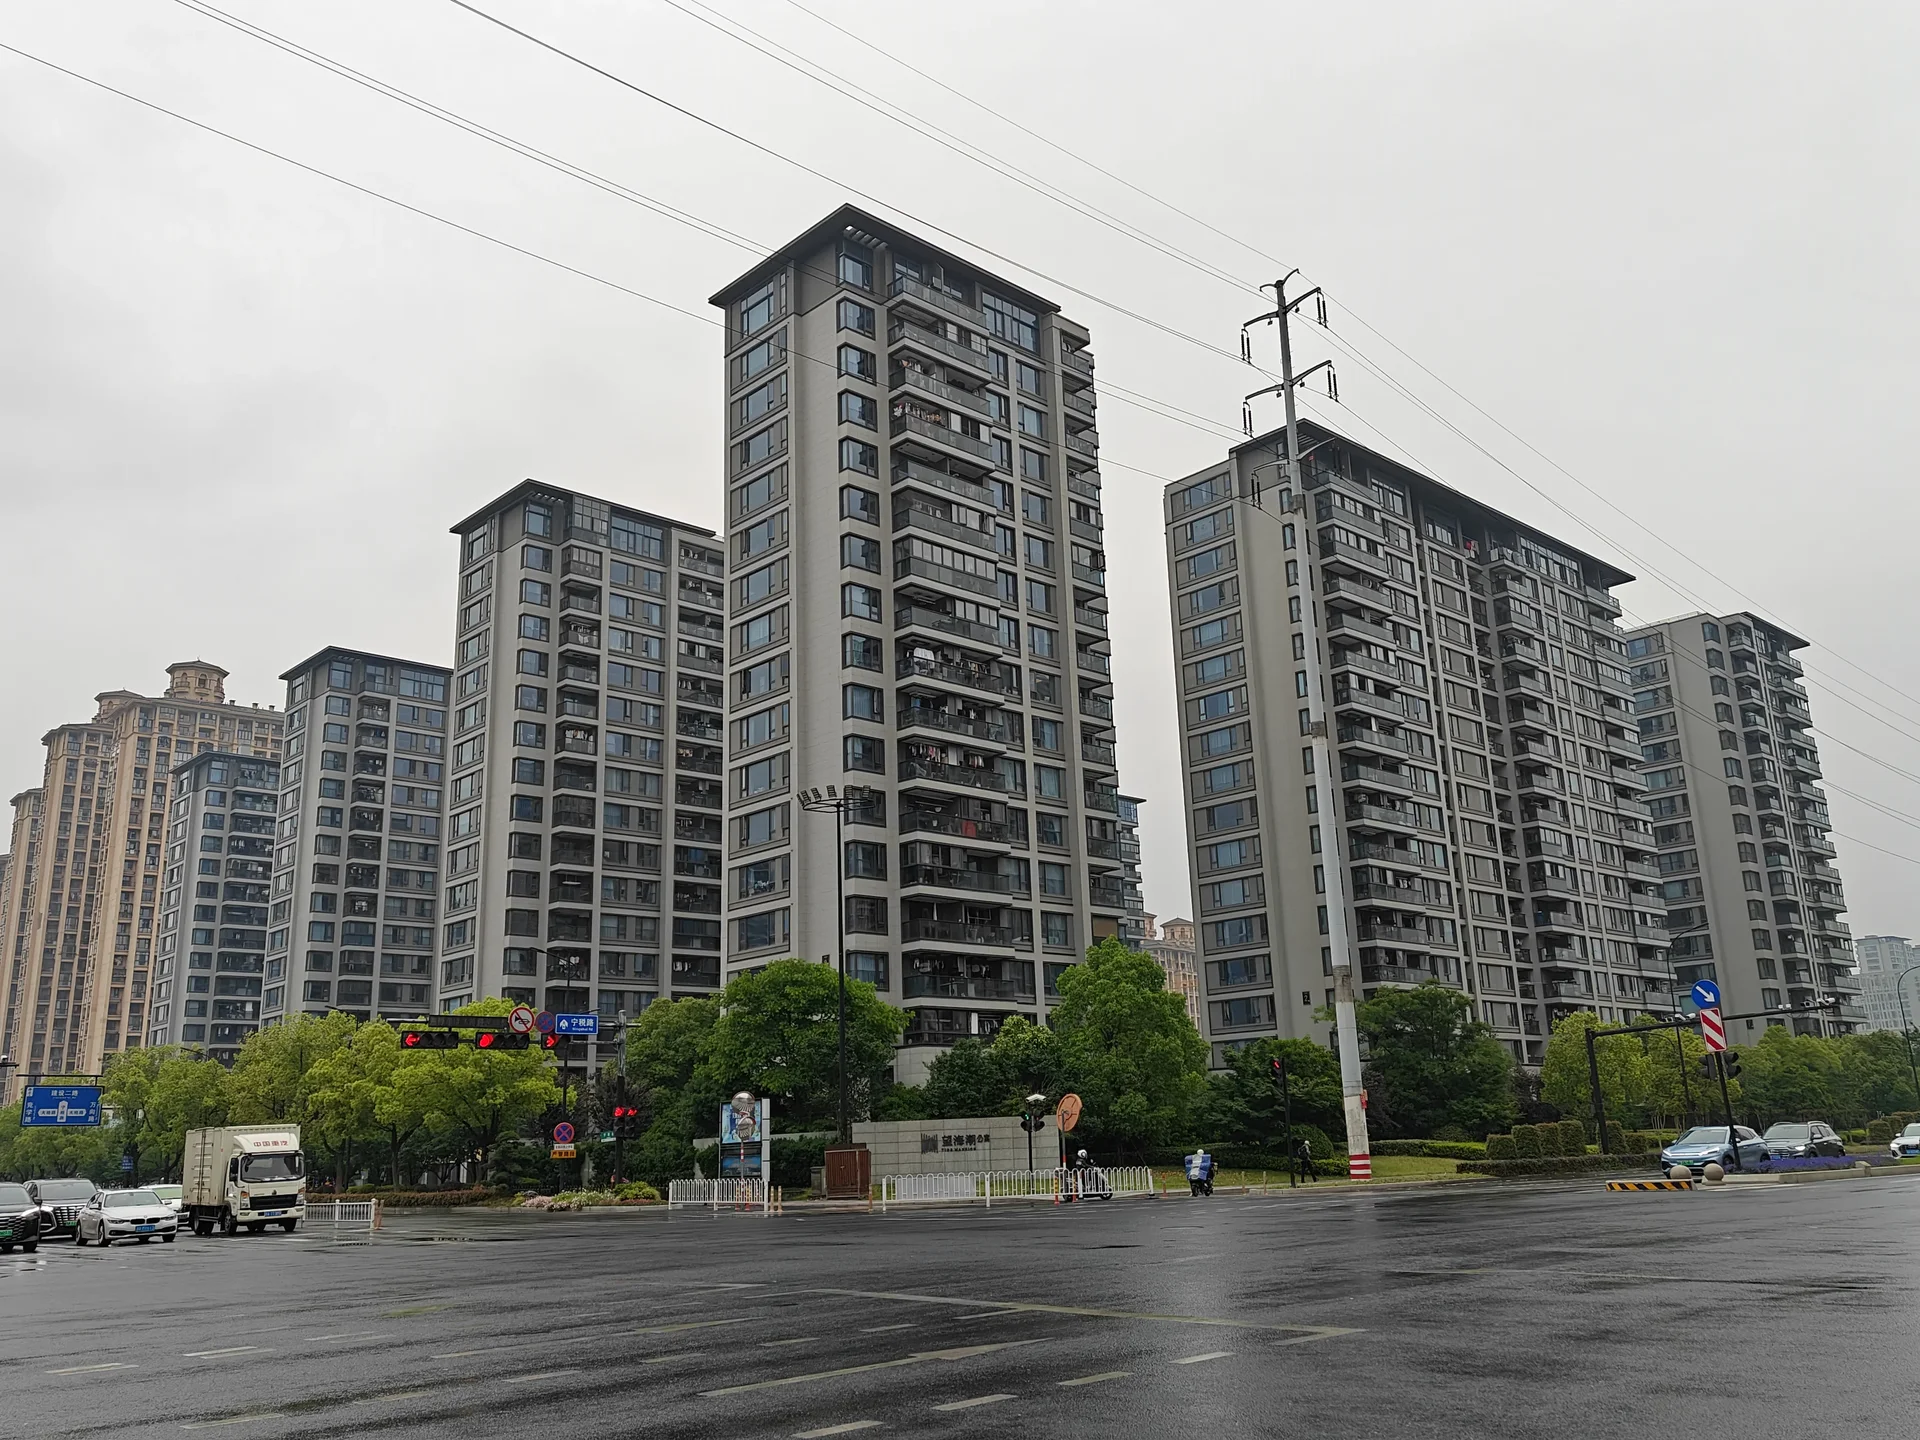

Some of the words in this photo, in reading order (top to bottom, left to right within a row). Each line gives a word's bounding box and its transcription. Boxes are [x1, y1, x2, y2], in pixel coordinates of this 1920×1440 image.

[571, 1018, 594, 1027] 宁税路
[51, 1089, 79, 1097] 建设二路
[87, 1102, 97, 1123] 万向路
[942, 1134, 990, 1147] 望海潮公寓
